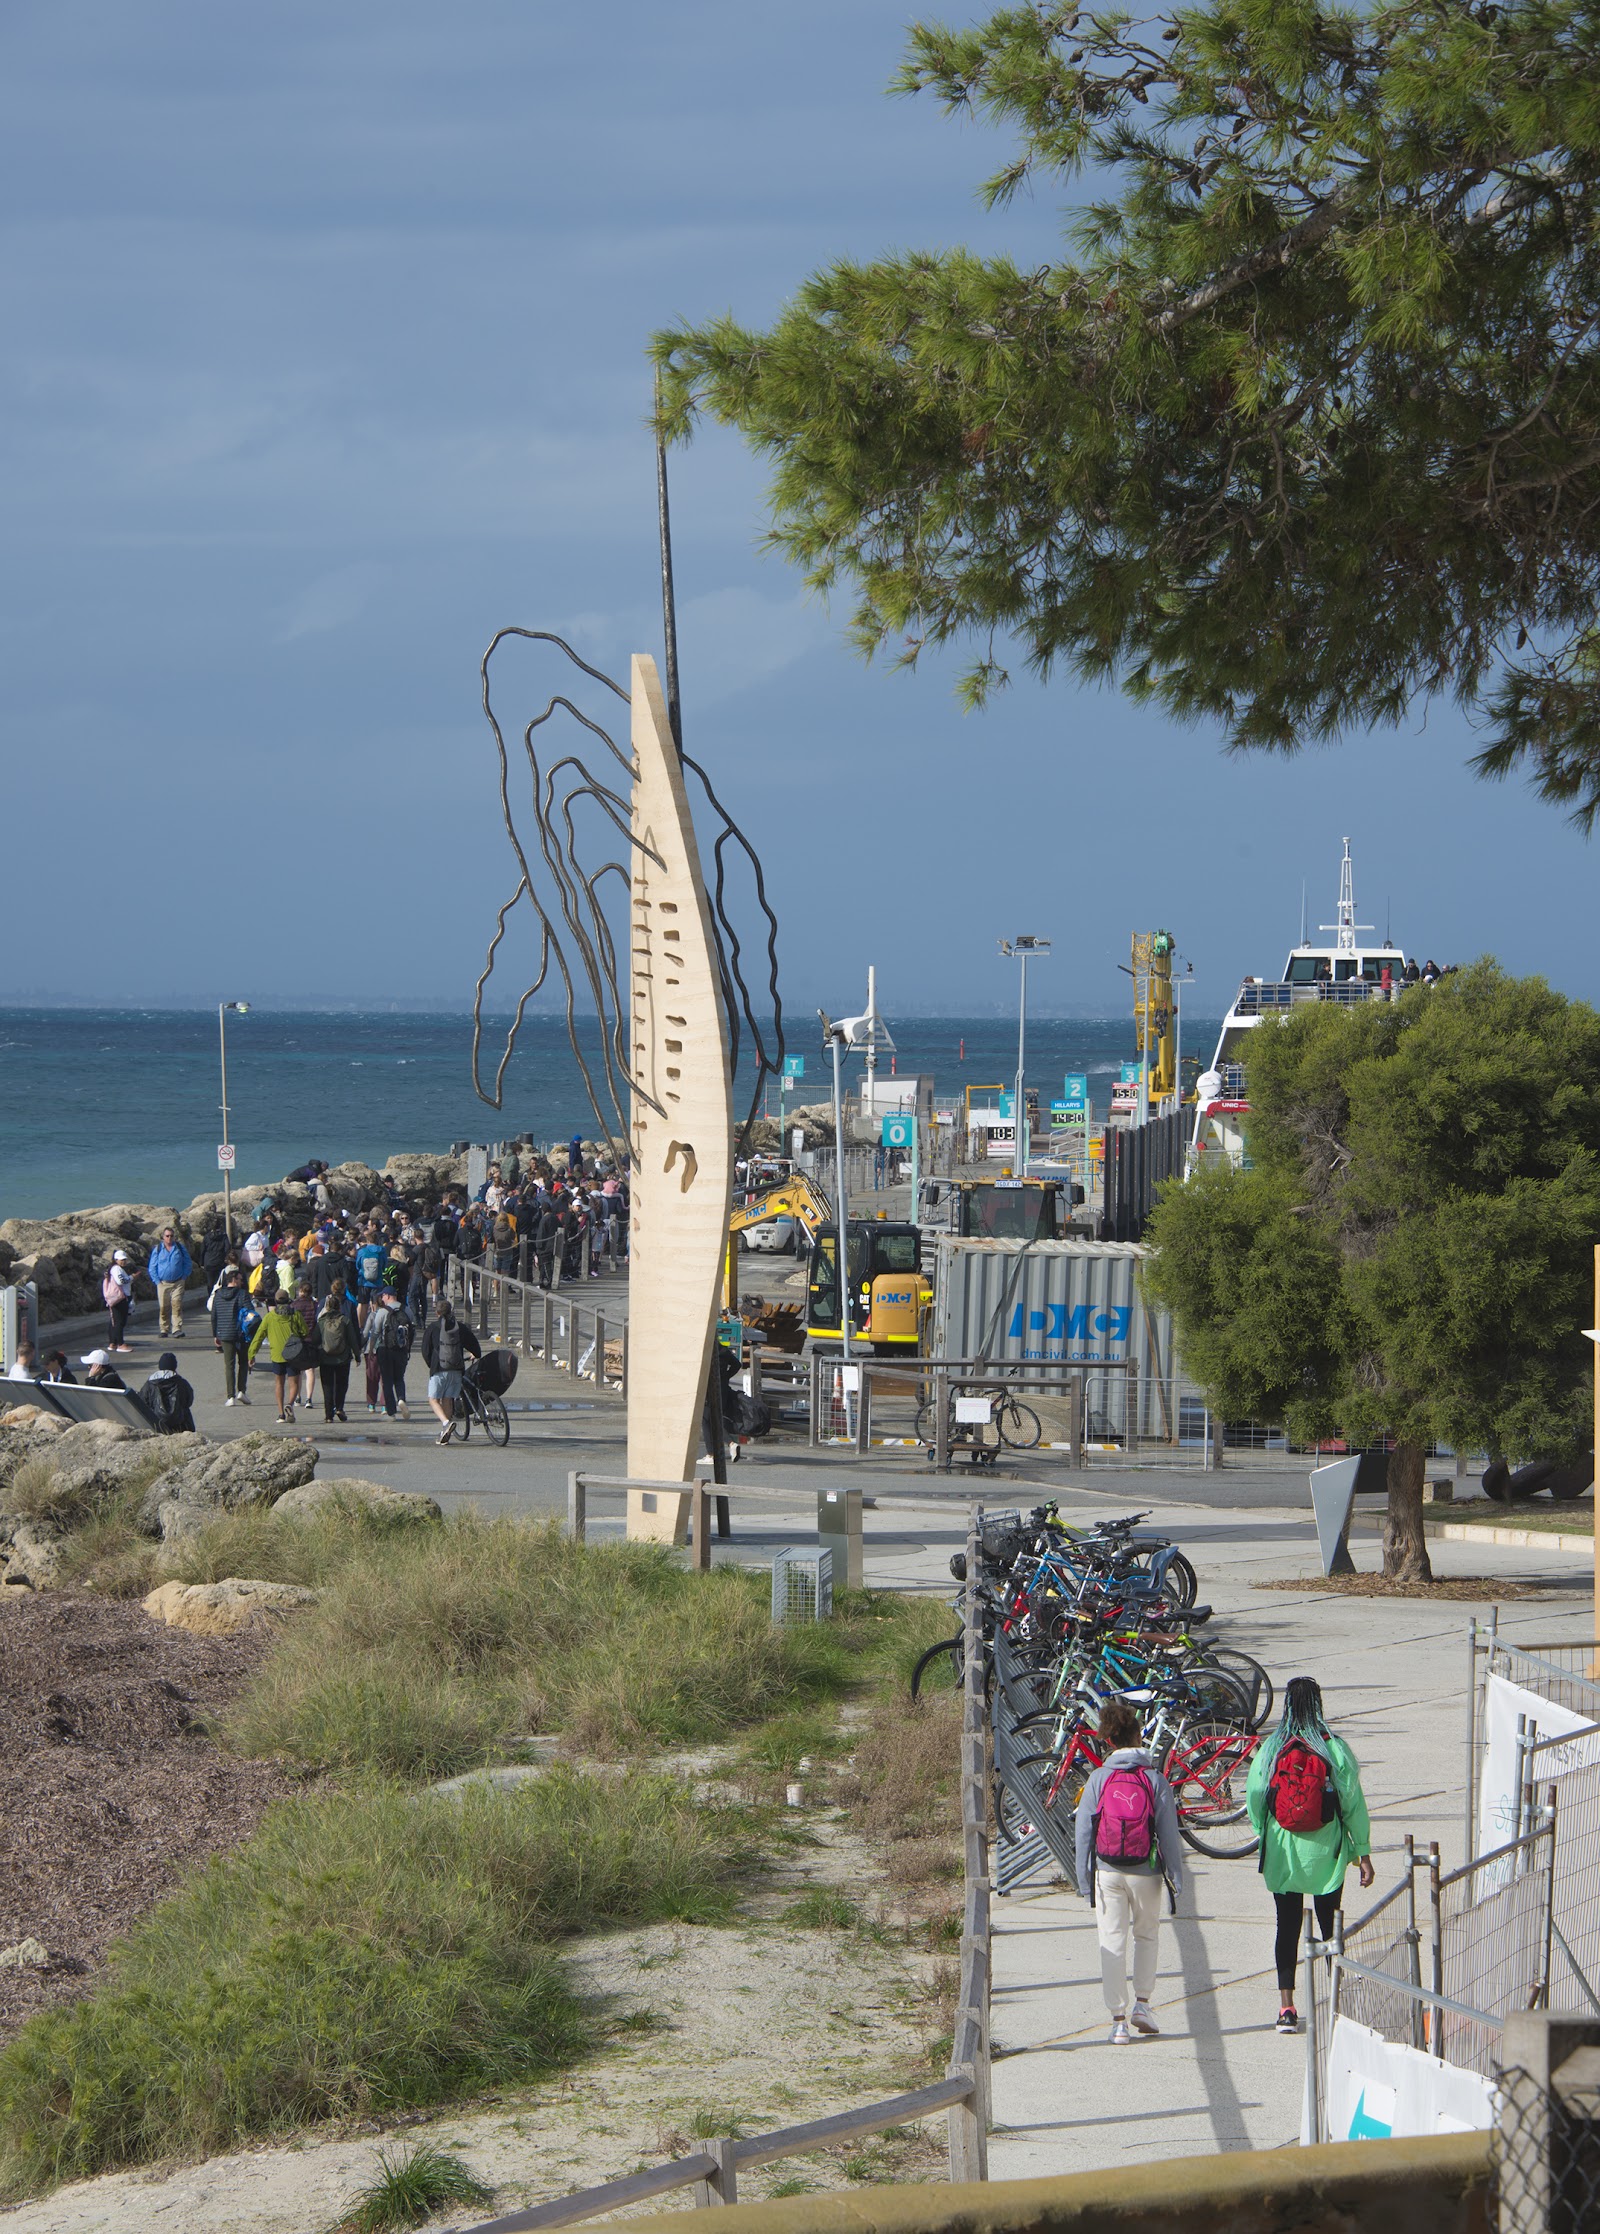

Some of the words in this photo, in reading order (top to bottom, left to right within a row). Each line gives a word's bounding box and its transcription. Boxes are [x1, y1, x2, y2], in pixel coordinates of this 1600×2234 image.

[790, 1060, 799, 1070] T
[1126, 1072, 1135, 1083] 3
[1070, 1083, 1081, 1097] 2
[1007, 1102, 1016, 1118] 1
[889, 1125, 906, 1144] 0
[859, 1294, 870, 1304] CAT
[1021, 1348, 1120, 1361] dmcivil.com.au
